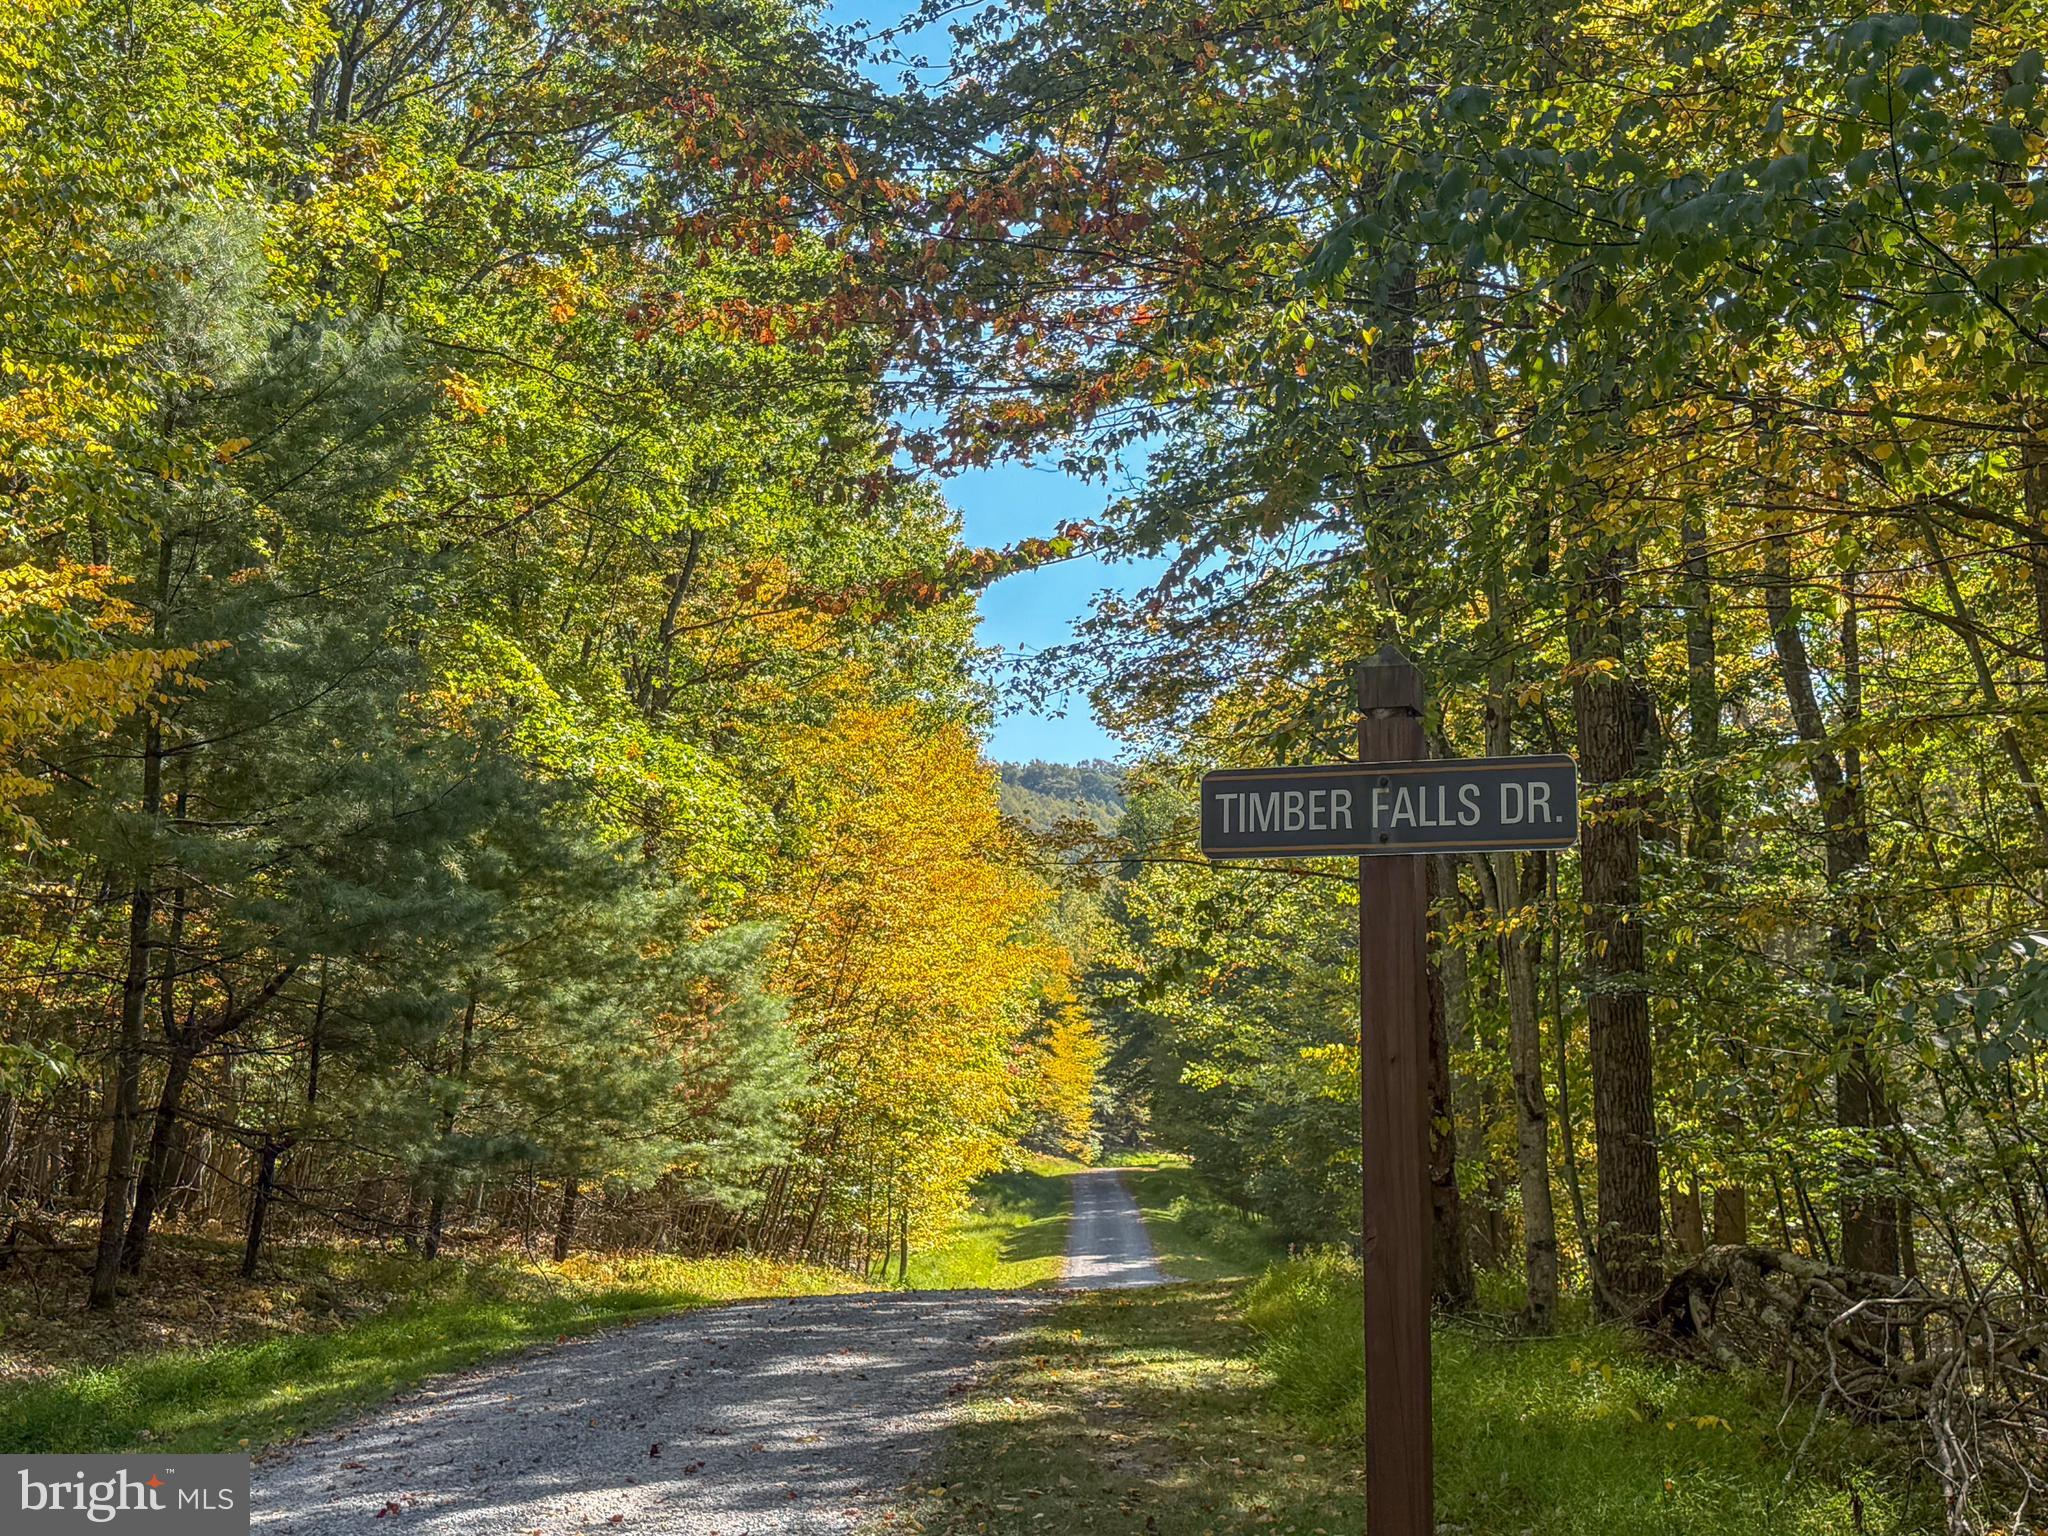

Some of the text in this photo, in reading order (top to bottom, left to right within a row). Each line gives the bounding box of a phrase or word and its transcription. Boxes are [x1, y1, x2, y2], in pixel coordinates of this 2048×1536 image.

[1215, 781, 1563, 834] TIMBER FALLS DR.
